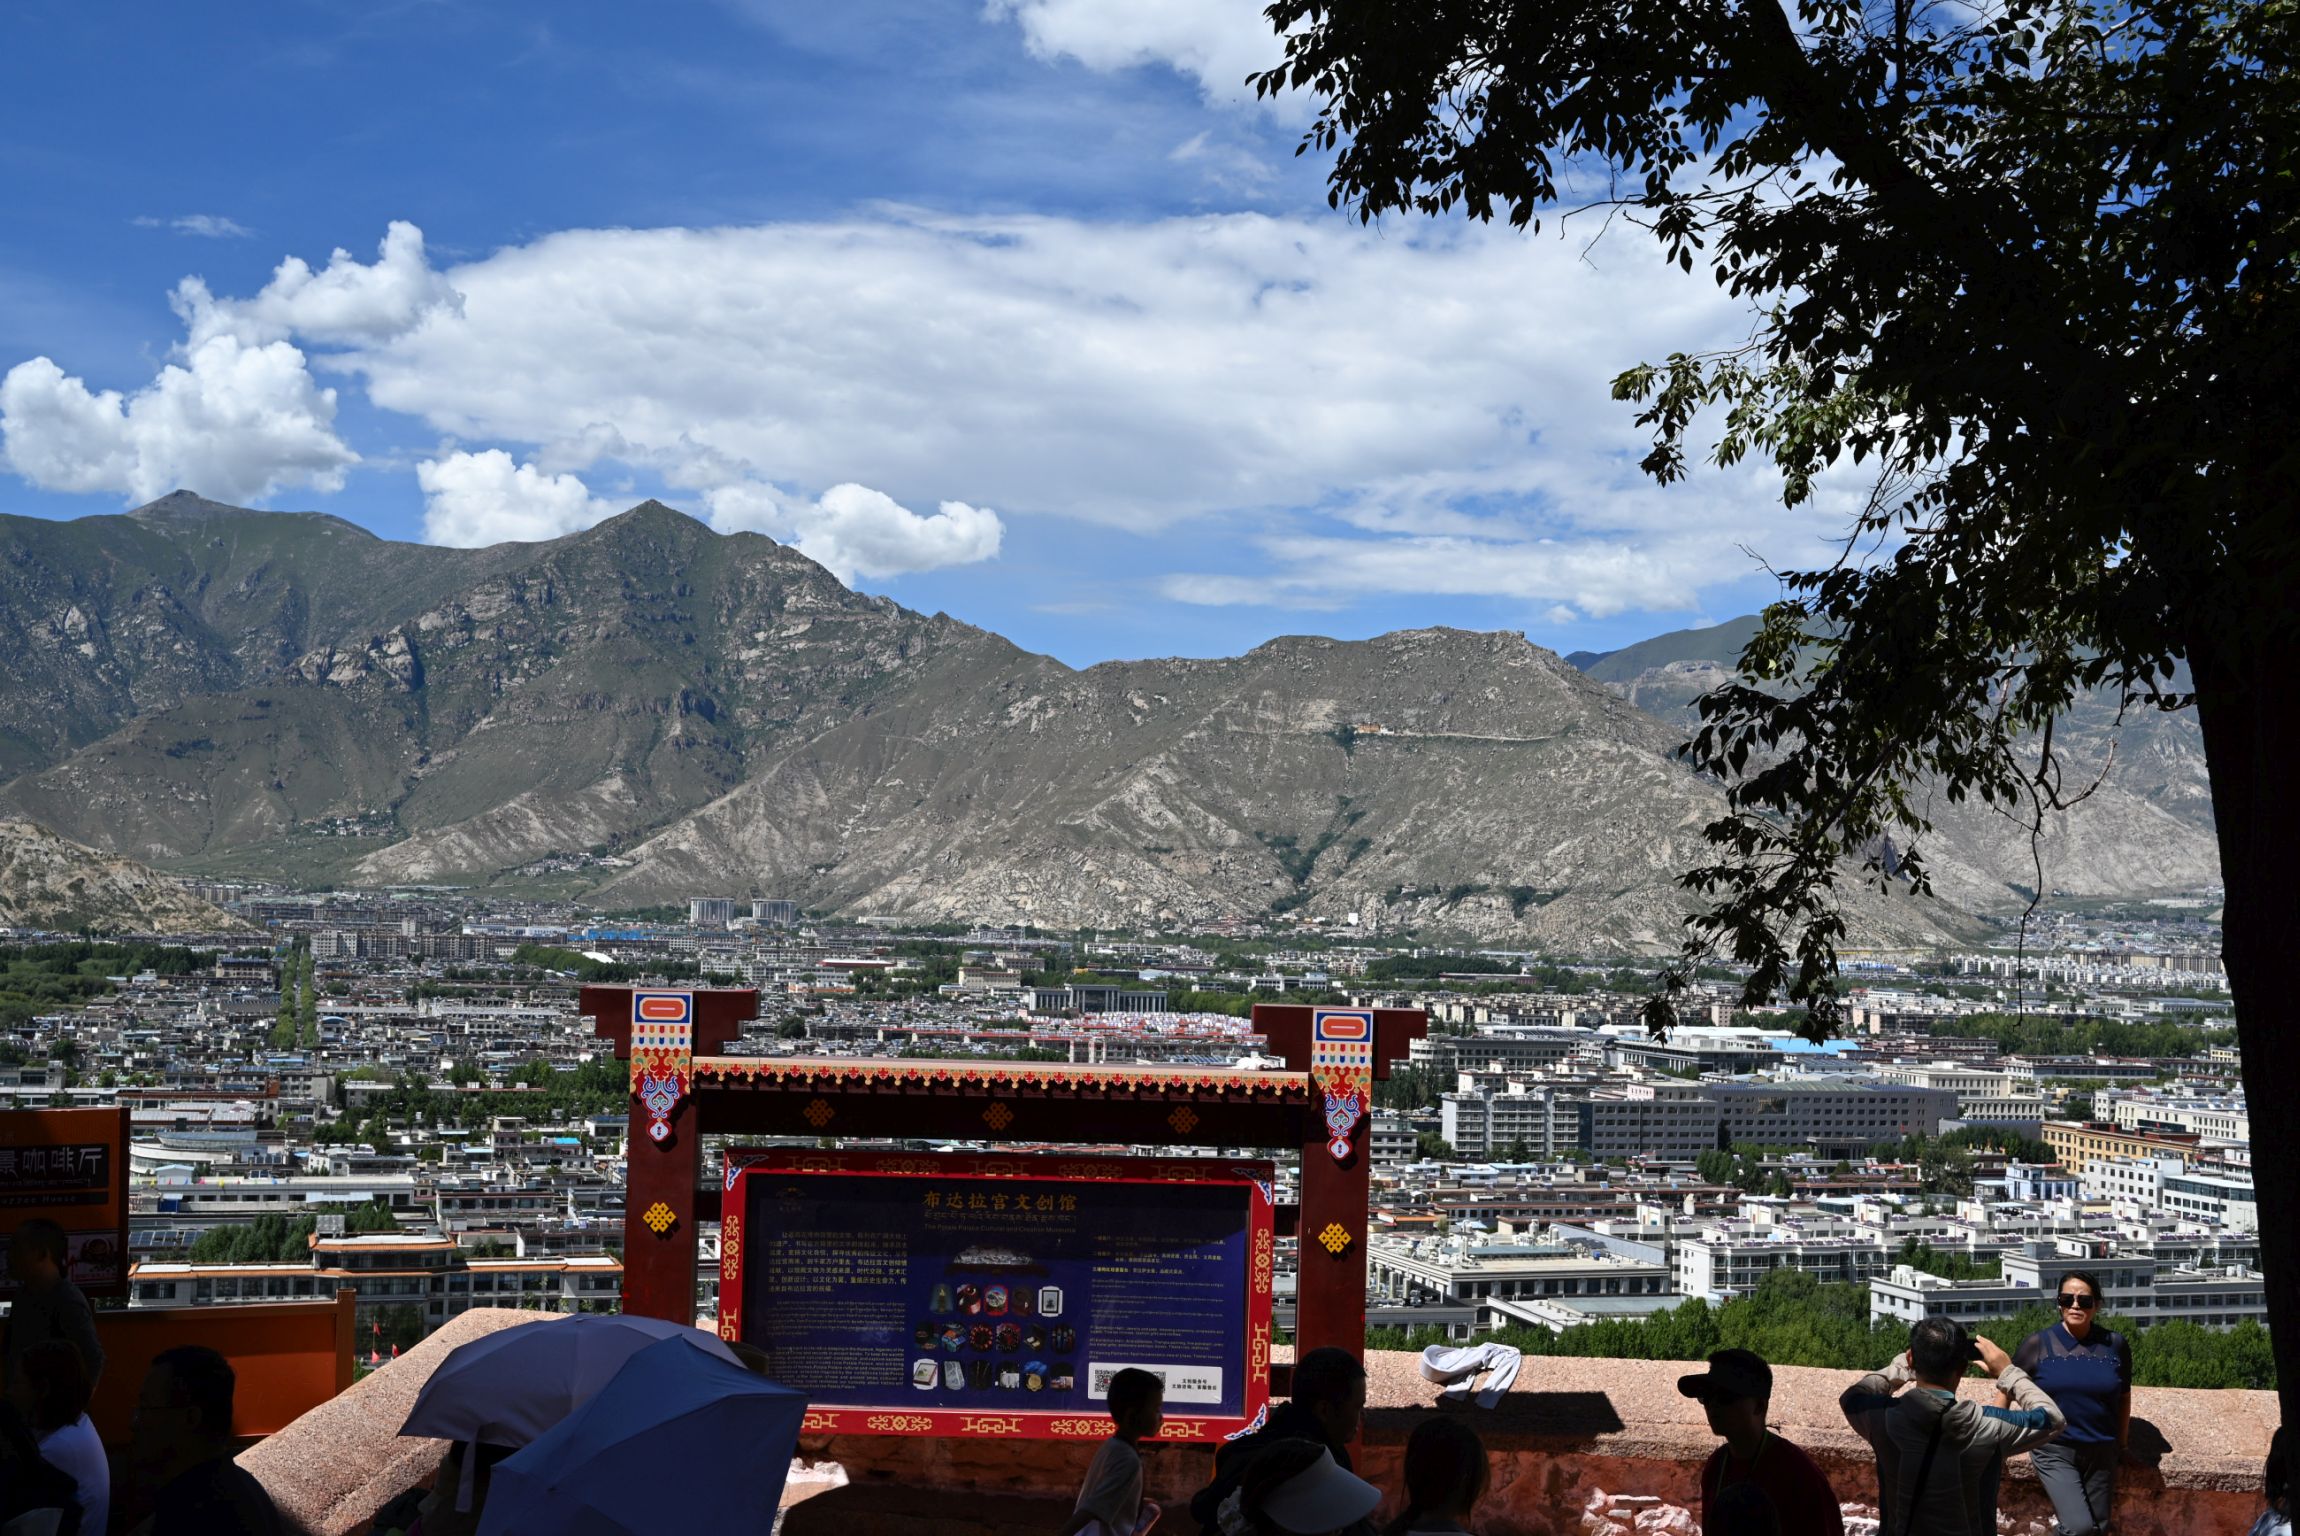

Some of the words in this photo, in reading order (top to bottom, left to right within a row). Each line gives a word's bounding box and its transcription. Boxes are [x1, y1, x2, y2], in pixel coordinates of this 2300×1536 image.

[922, 1190, 1079, 1211] 布达拉宫文创馆
